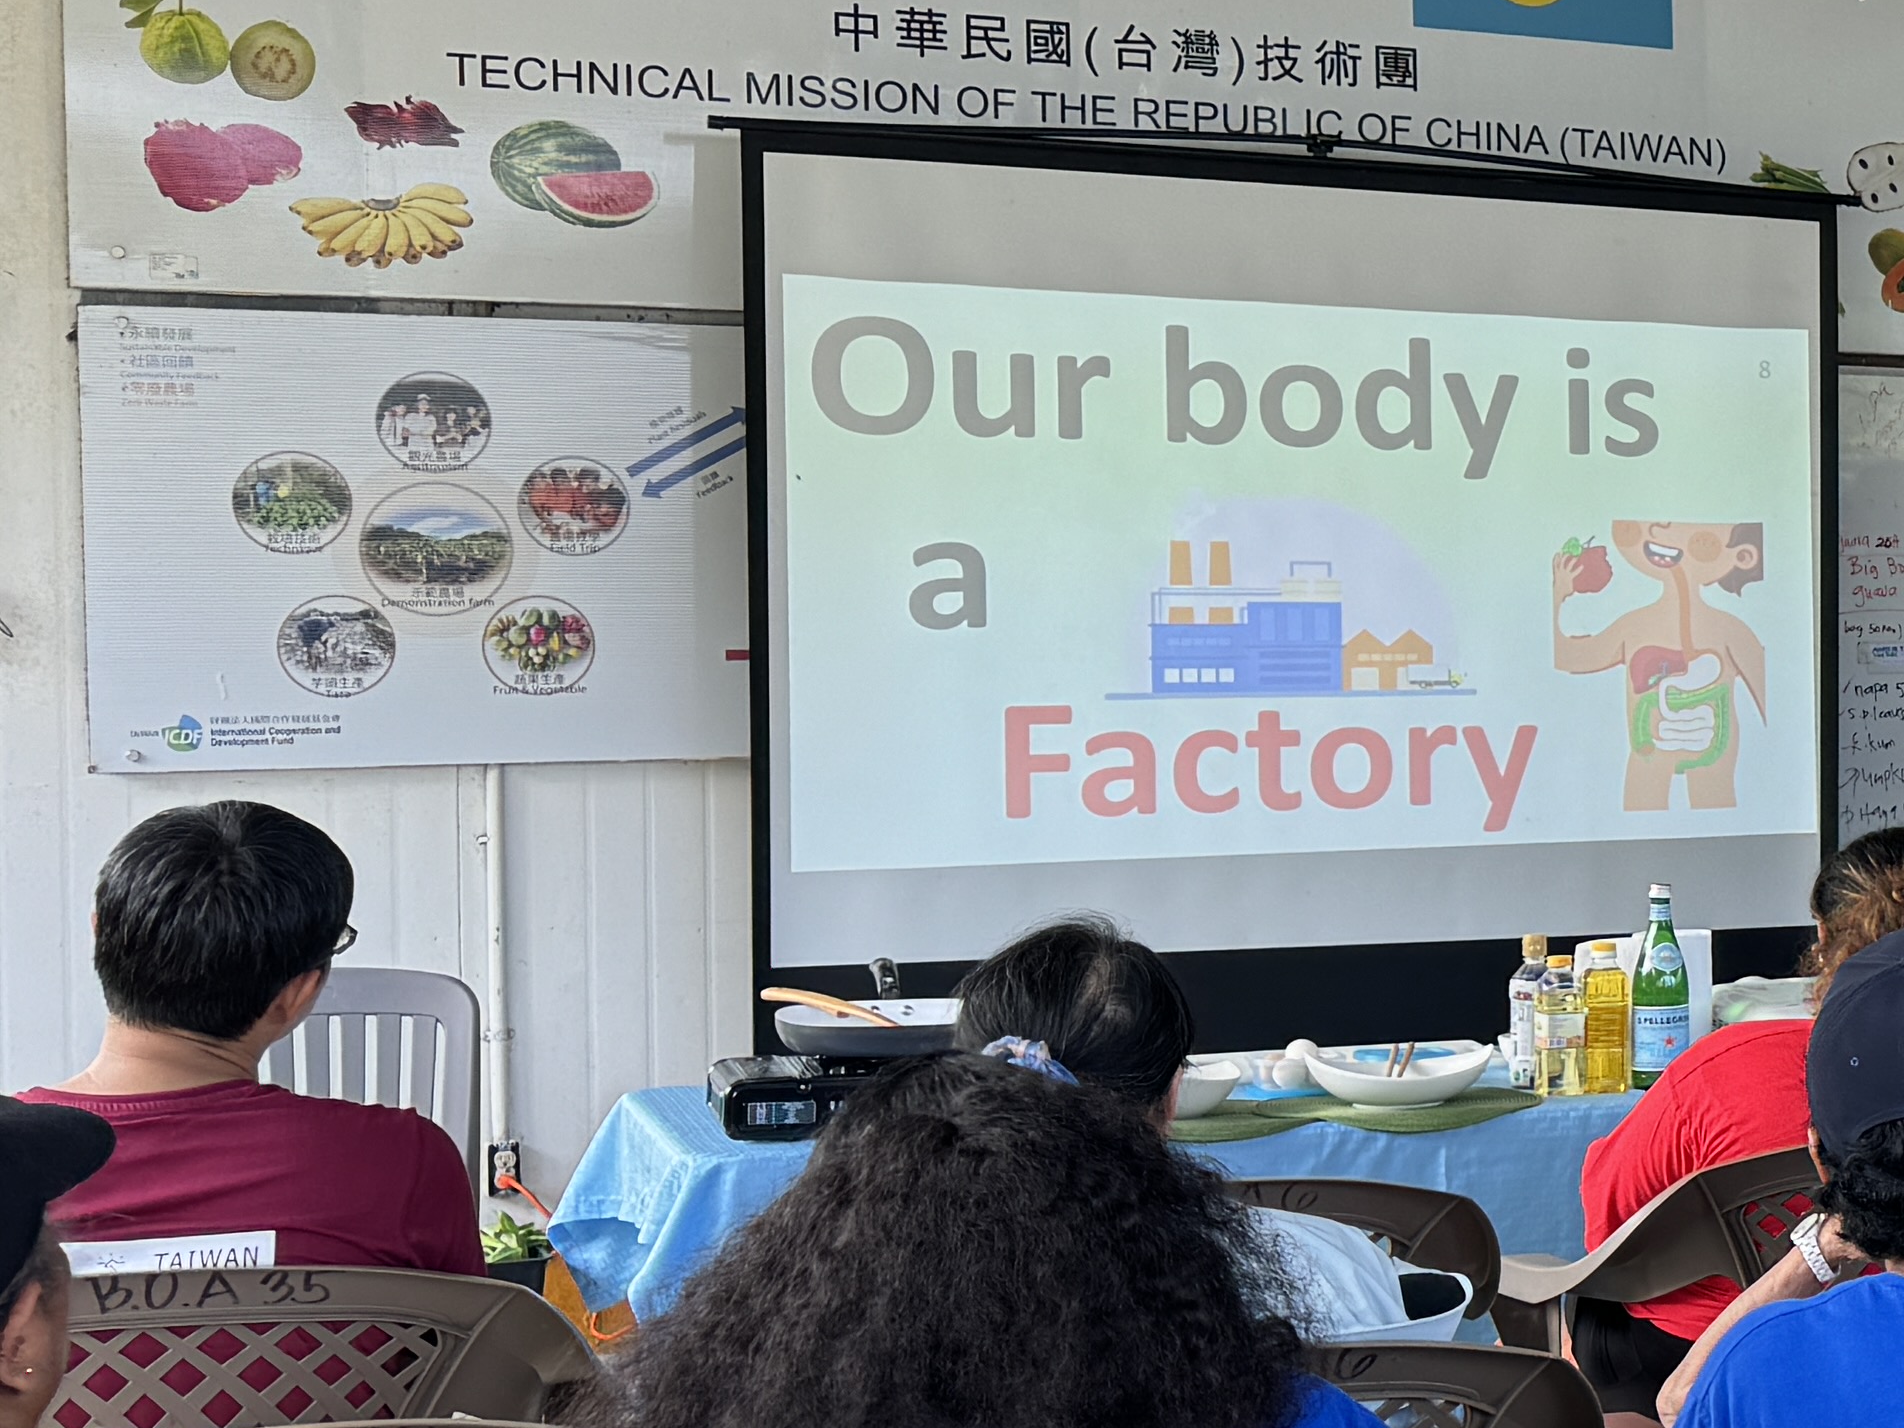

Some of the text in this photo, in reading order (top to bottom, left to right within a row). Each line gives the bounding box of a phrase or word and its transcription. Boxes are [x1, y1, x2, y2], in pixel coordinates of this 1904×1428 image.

[833, 3, 1419, 92] 中華民國(台灣)技術團
[446, 52, 1728, 175] TECHNICAL MISSION OF THE REPUBLIC OF CHINA (TAIWAN)
[811, 315, 1771, 480] Our body is 8
[908, 539, 988, 632] a
[1849, 556, 1879, 579] Big
[163, 728, 203, 745] ICDF
[210, 726, 266, 736] International
[1003, 704, 1538, 833] Factory
[153, 1245, 260, 1269] TAIWAN
